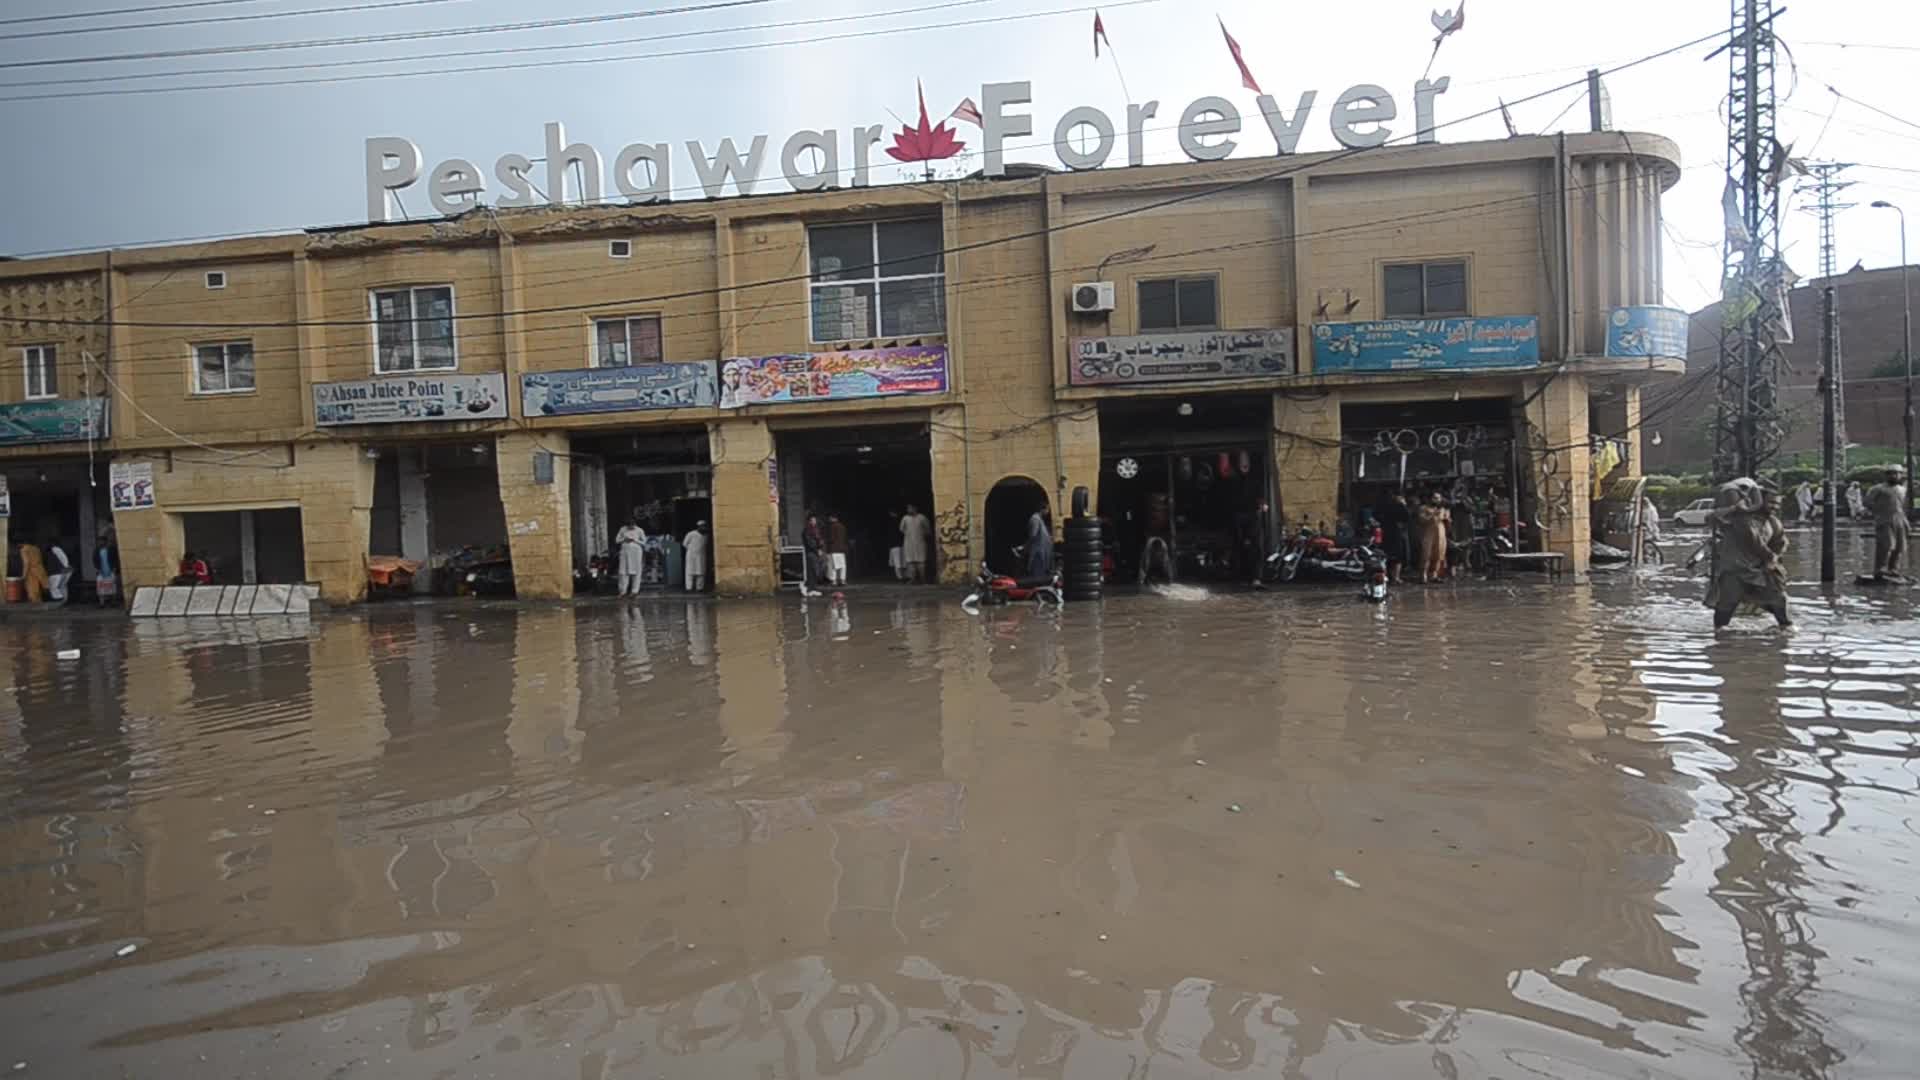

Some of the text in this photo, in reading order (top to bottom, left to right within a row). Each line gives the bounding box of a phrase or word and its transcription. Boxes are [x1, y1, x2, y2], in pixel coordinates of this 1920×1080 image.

[365, 75, 1451, 224] Peshawar Forever
[330, 380, 445, 401] Ahsan Juice Point
